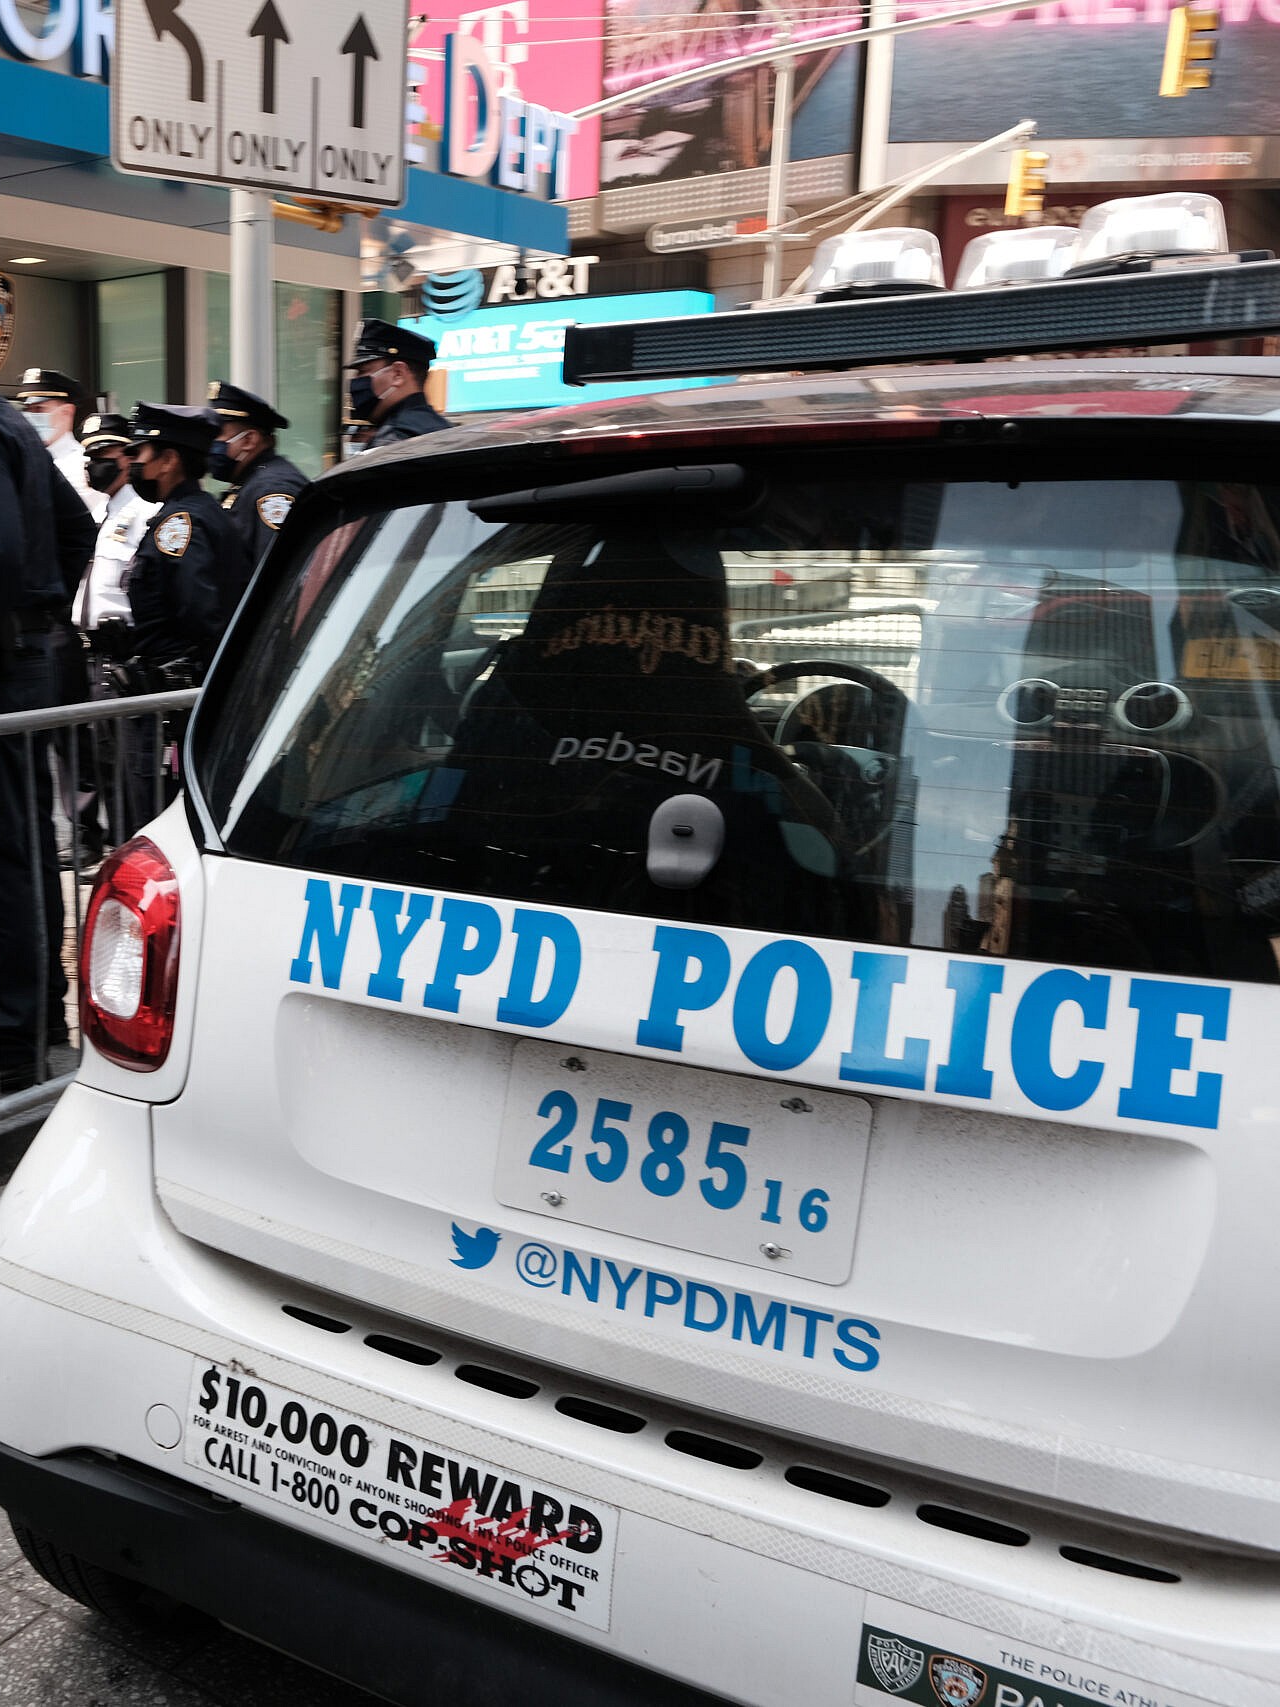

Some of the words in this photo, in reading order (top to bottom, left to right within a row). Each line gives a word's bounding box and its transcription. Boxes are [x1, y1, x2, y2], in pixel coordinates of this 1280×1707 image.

[129, 115, 212, 160] ONLY
[228, 130, 307, 173] ONLY
[443, 32, 580, 201] DEPT
[320, 145, 393, 186] ONLY
[487, 255, 600, 303] AT&T
[436, 324, 517, 358] AT&T
[289, 878, 583, 1029] NYPD
[635, 925, 1232, 1130] POLICE
[529, 1091, 749, 1210] 2585
[761, 1179, 831, 1234] 16
[516, 1240, 881, 1373] @NYPDMTS
[193, 1415, 211, 1431] FOR
[214, 1423, 249, 1445] ARREST
[251, 1435, 272, 1454] AND
[275, 1447, 336, 1480] CONVICTION
[339, 1473, 353, 1486] OF
[356, 1479, 401, 1505] ANYONE
[404, 1497, 463, 1529] SHOOTING
[505, 1535, 546, 1562] POLICE
[549, 1553, 600, 1583] OFFICER
[198, 1365, 370, 1468] $10,000
[385, 1438, 603, 1555] REWARD
[204, 1437, 261, 1486] CALL
[270, 1461, 340, 1516] 1-800
[998, 1649, 1035, 1675] THE
[1040, 1664, 1110, 1699] POLICE
[1113, 1689, 1177, 1707] ATH
